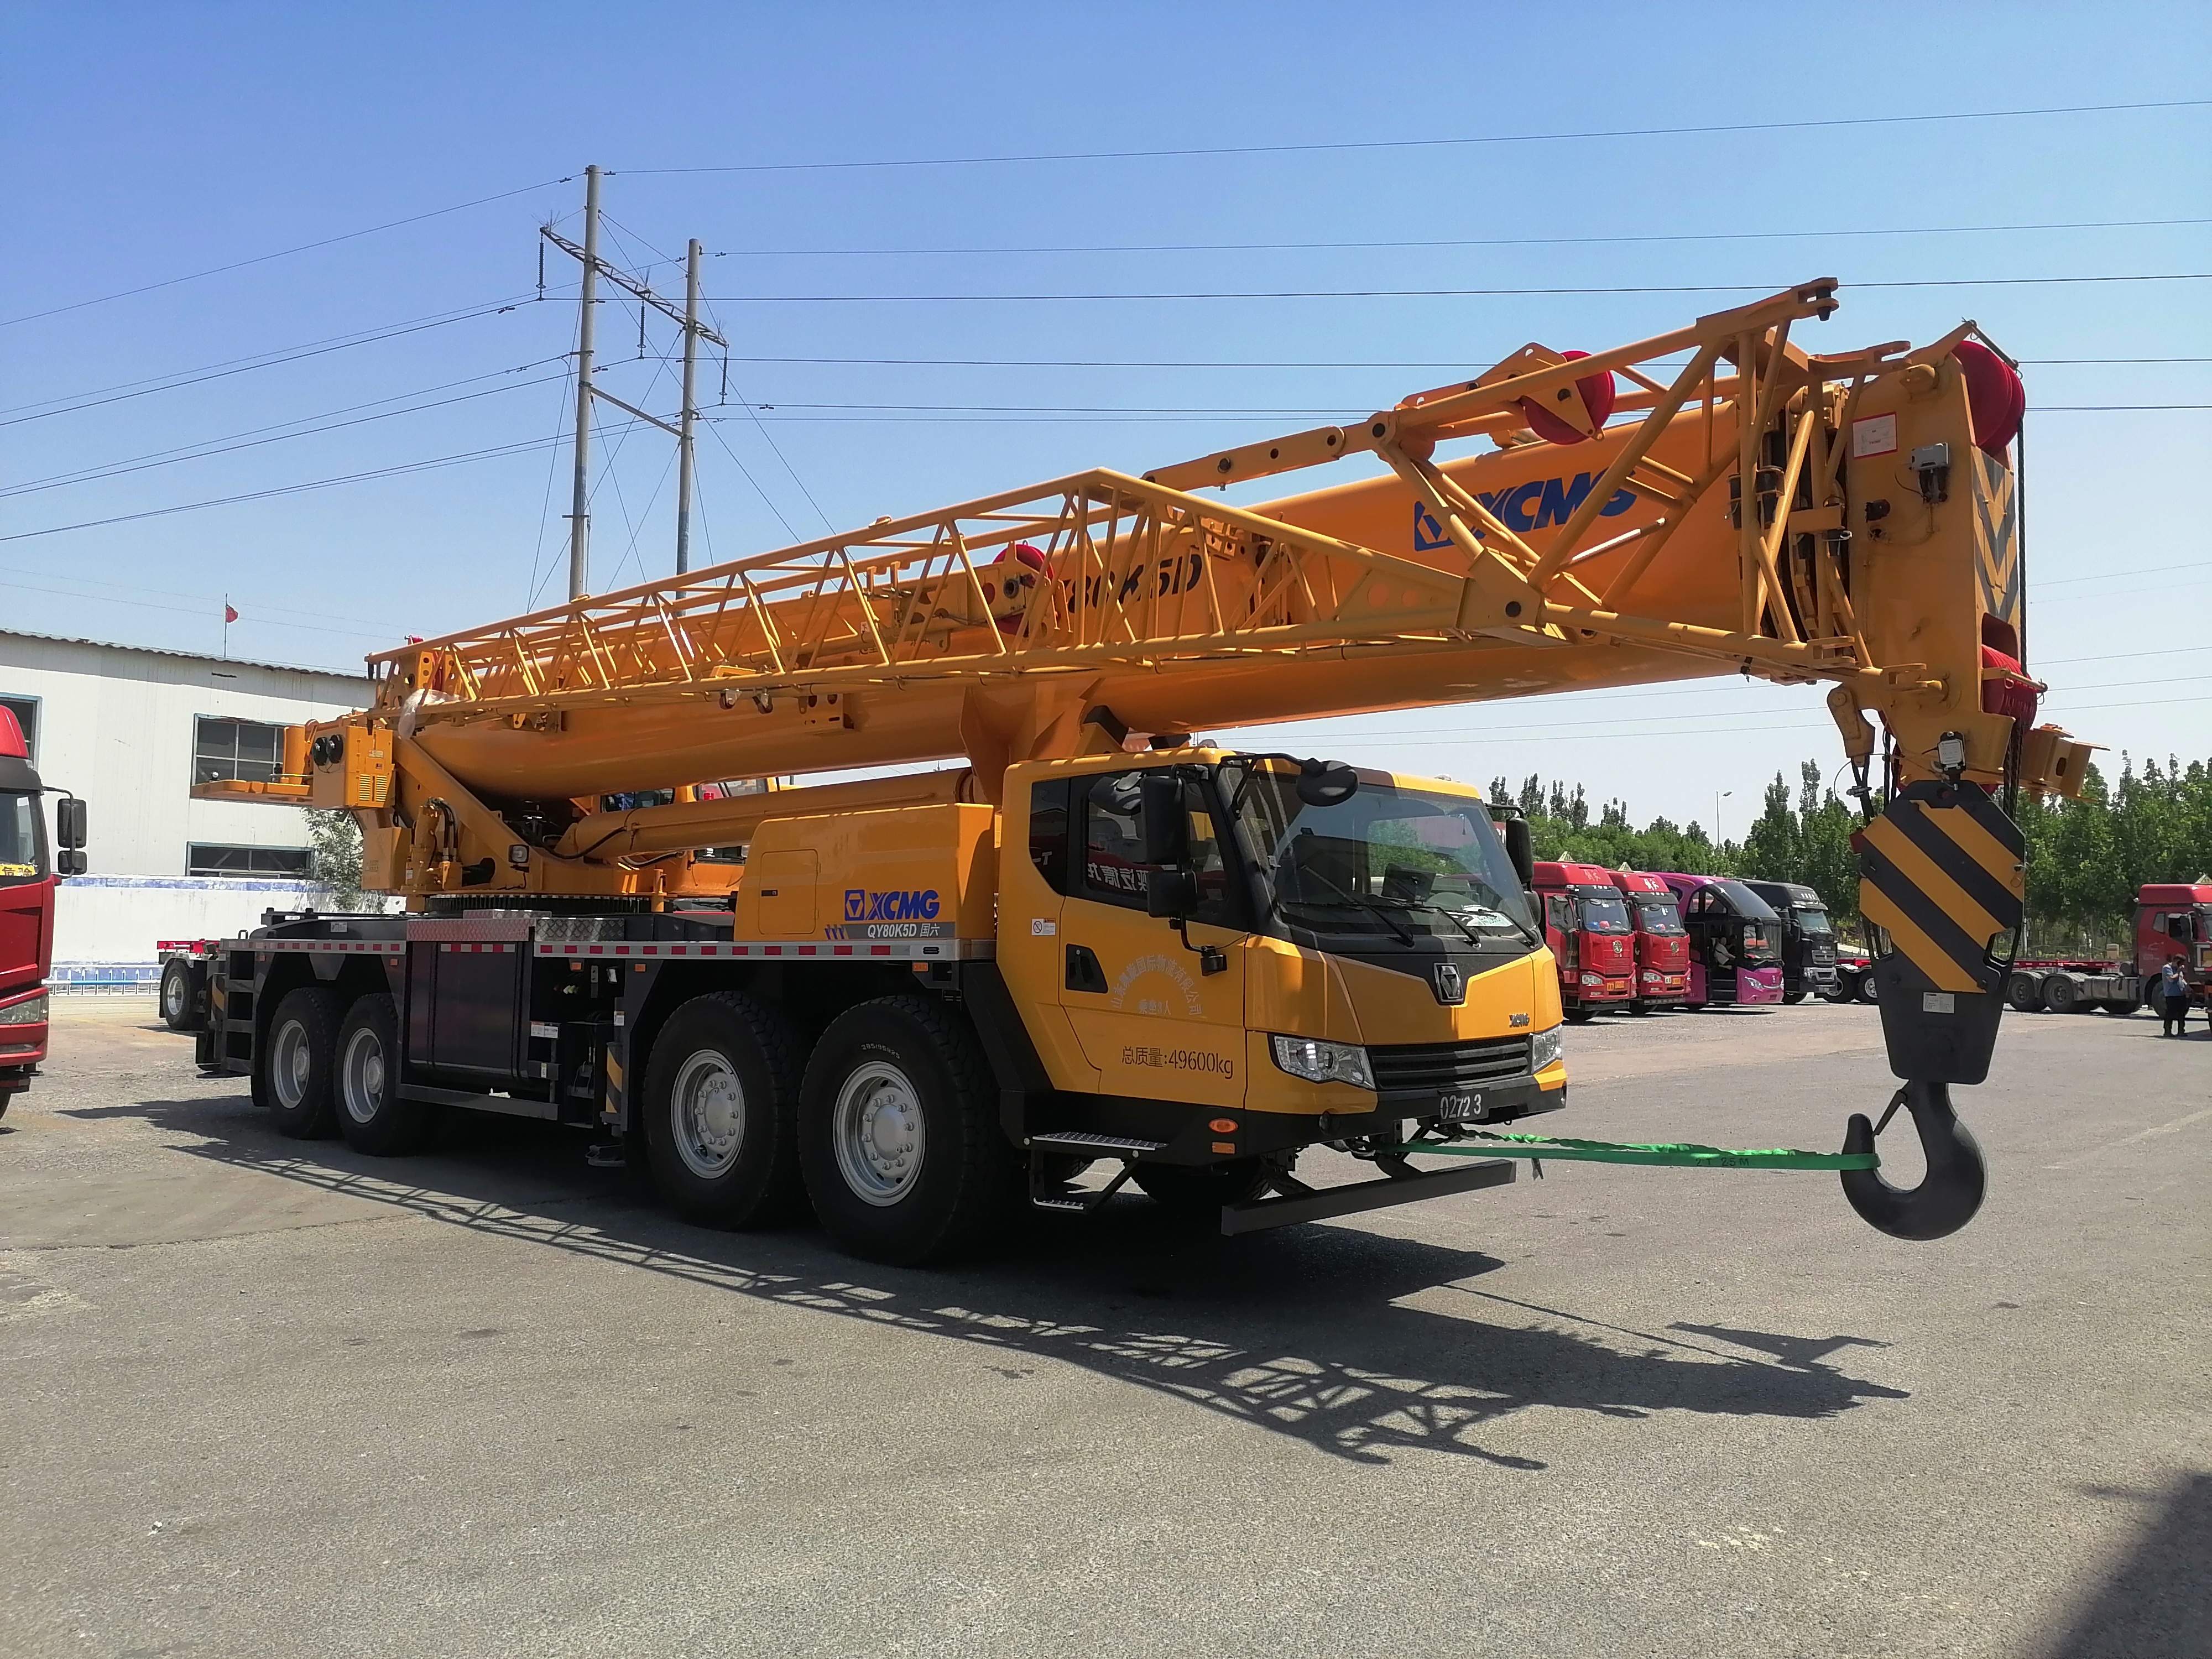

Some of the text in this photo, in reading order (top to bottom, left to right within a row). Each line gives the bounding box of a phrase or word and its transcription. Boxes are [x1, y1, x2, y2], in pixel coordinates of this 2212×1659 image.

[865, 890, 940, 920] XCMG
[868, 923, 940, 938] QY80K5D 国六
[1121, 1045, 1234, 1080] 总质量:49600kg
[1439, 1093, 1482, 1120] 02723
